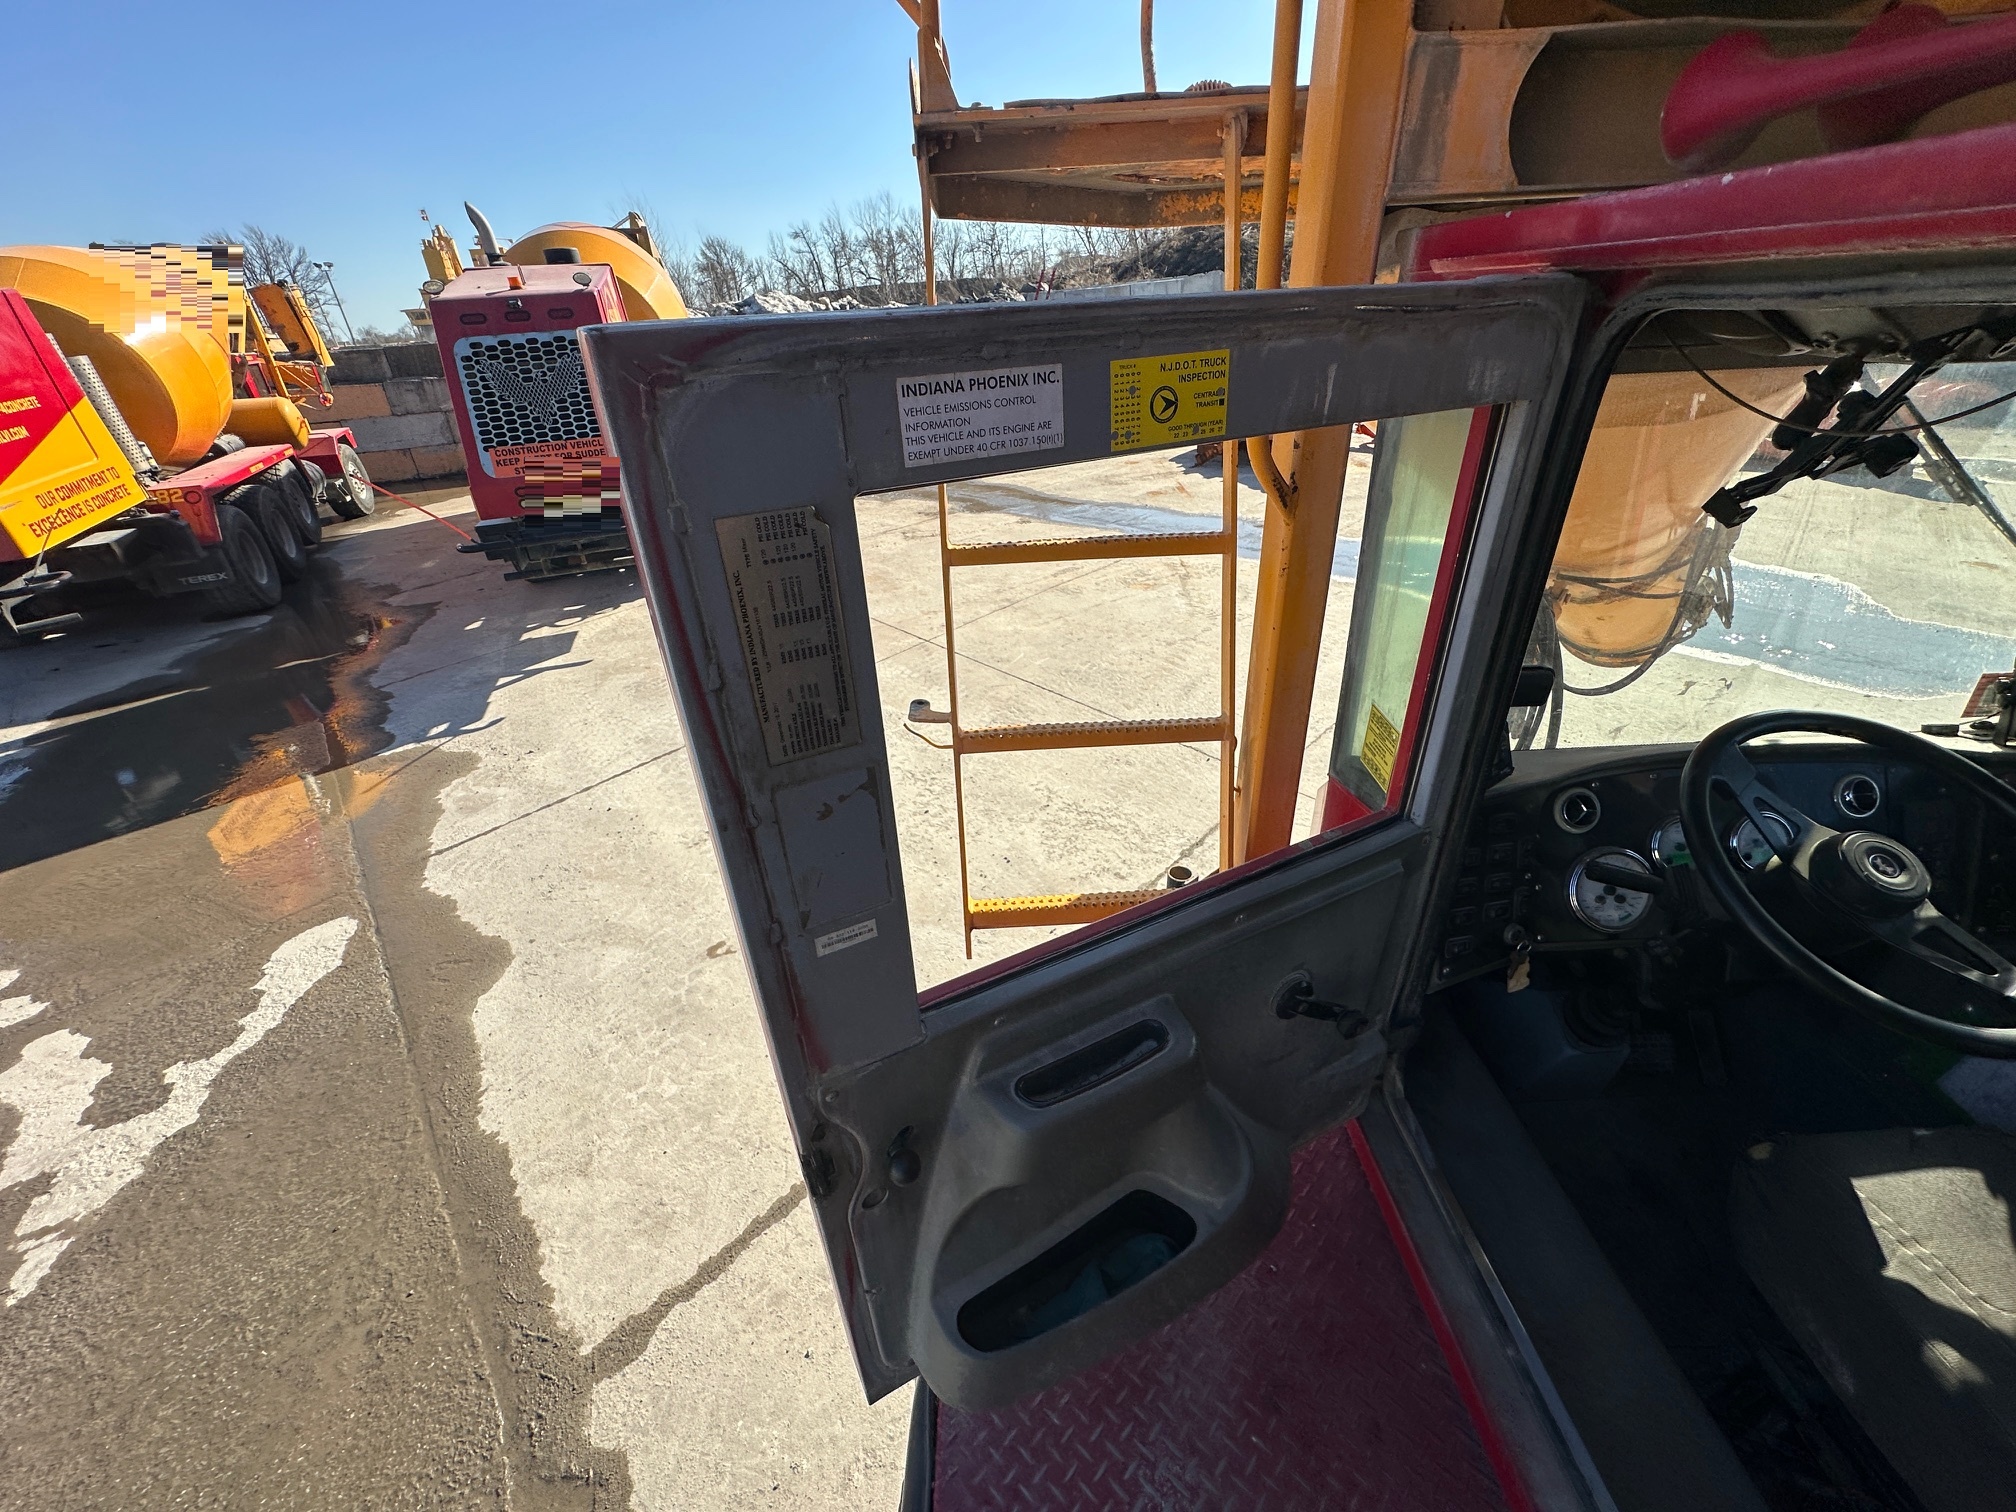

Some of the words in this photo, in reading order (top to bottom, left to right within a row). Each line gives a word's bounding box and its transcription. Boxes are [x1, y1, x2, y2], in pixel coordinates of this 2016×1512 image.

[1160, 360, 1197, 372] N.J.D.O.T.
[1200, 357, 1226, 367] TRUCK
[901, 379, 965, 398] INDIANA
[969, 372, 1029, 391] PHOENIX
[1032, 370, 1060, 386] INC.
[1178, 370, 1226, 383] INSPECTION
[1194, 390, 1218, 399] CENTRAL
[903, 404, 941, 417] VEHICLE
[944, 399, 992, 414] EMISSIONS
[994, 395, 1036, 408] CONTROL
[1196, 400, 1218, 408] TRANSIT
[905, 417, 971, 433] INFORMATION
[905, 436, 926, 446] THIS
[927, 432, 964, 445] VEHICLE
[966, 428, 986, 439] AND
[988, 426, 1001, 436] ITS
[1003, 423, 1035, 435] ENGINE
[1037, 420, 1052, 430] ARE
[0, 425, 30, 444] LVI.COM
[495, 443, 567, 457] CONSTRUCTION
[908, 449, 940, 461] EXEMPT
[944, 445, 974, 457] UNDER
[977, 442, 988, 452] 40
[989, 440, 1006, 451] CFR
[496, 458, 520, 467] KEEP
[35, 490, 58, 509] OUR
[54, 470, 110, 501] COMMITMENT
[106, 466, 120, 479] TO
[28, 503, 87, 538] EXCELLENCE
[83, 500, 95, 514] IS
[94, 484, 131, 510] CONCRETE
[178, 572, 228, 585] TEREX
[733, 570, 741, 586] INC.
[736, 587, 749, 623] PHOENIX,
[743, 623, 756, 655] INDIANA
[750, 656, 758, 666] BY
[752, 666, 770, 723] MANUFACTURED
